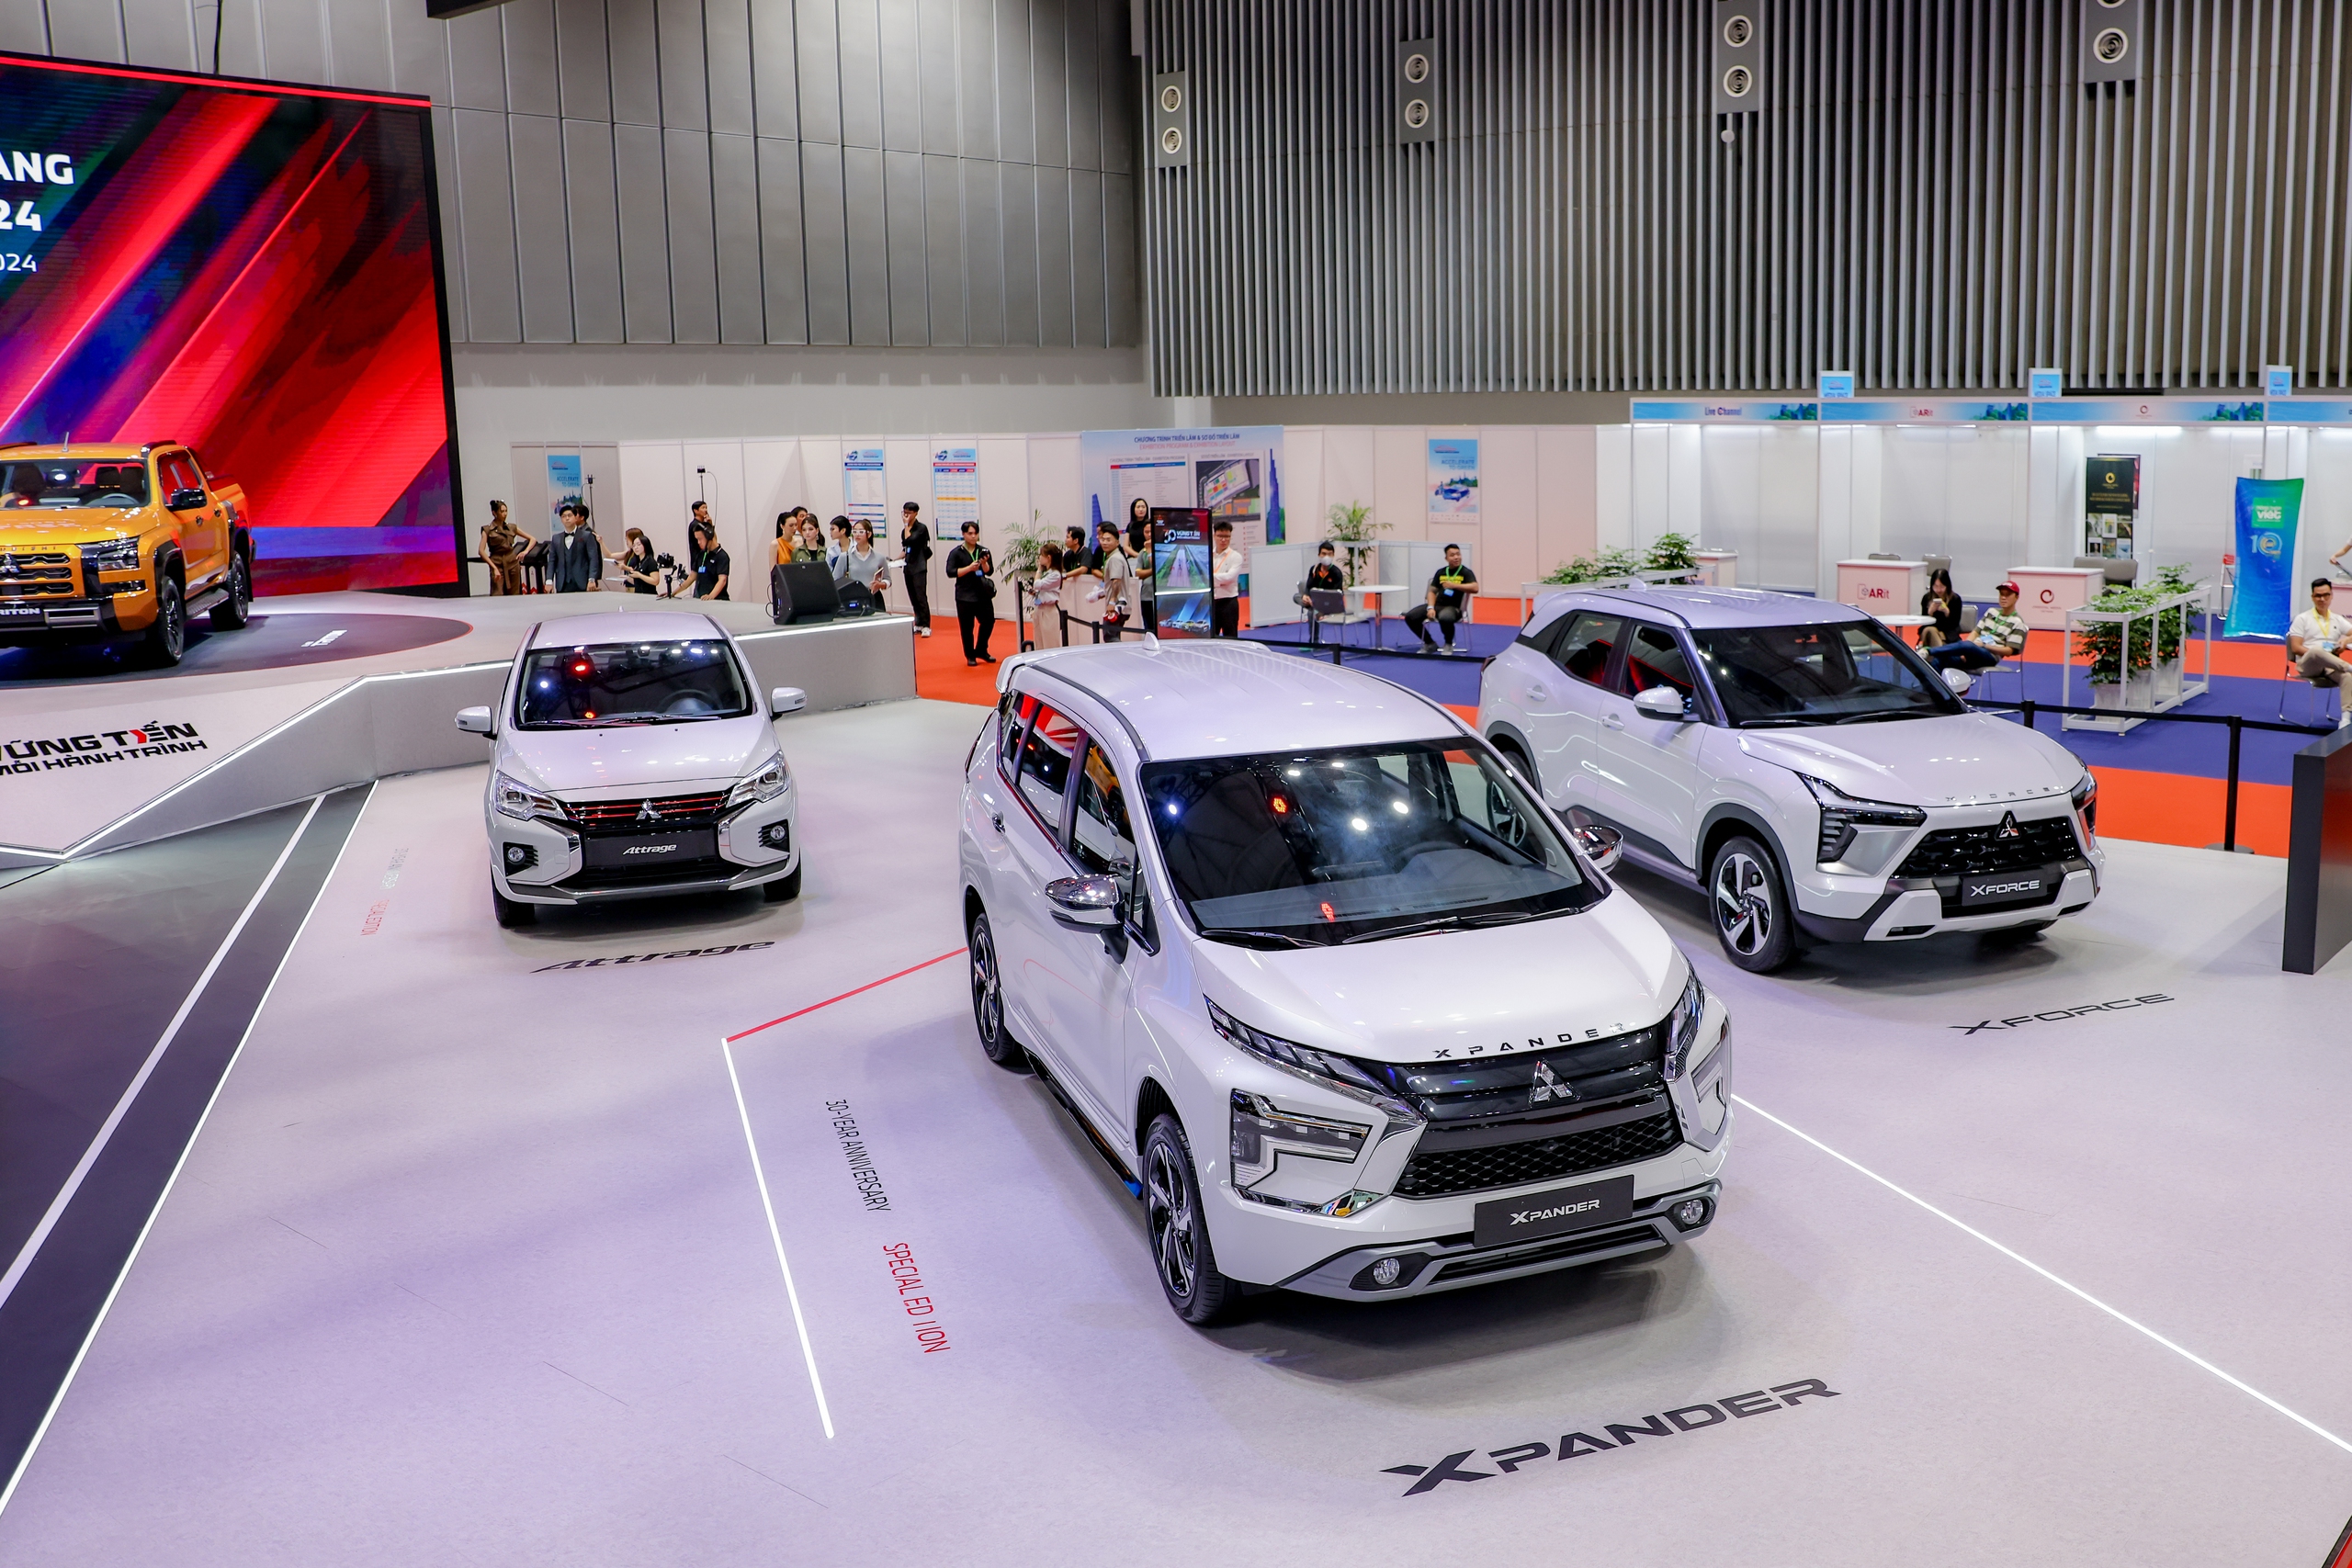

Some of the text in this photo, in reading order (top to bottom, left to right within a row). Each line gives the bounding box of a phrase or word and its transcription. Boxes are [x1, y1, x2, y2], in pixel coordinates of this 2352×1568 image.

[1704, 407, 1715, 416] Live
[1869, 588, 1890, 599] ARit
[0, 734, 102, 761] ỮNG
[42, 754, 125, 770] HÀNH
[123, 739, 209, 759] TRÌNH
[622, 843, 678, 855] Attrage
[1970, 879, 2041, 897] XFORCE
[529, 941, 775, 974] Attrage
[1946, 993, 2176, 1036] XFORCE
[825, 1099, 892, 1212] 30-YEAR ANNIVERSARY
[1510, 1199, 1600, 1226] XPANDER
[882, 1242, 924, 1296] SPECIAL
[1378, 1378, 1842, 1498] XPANDER
